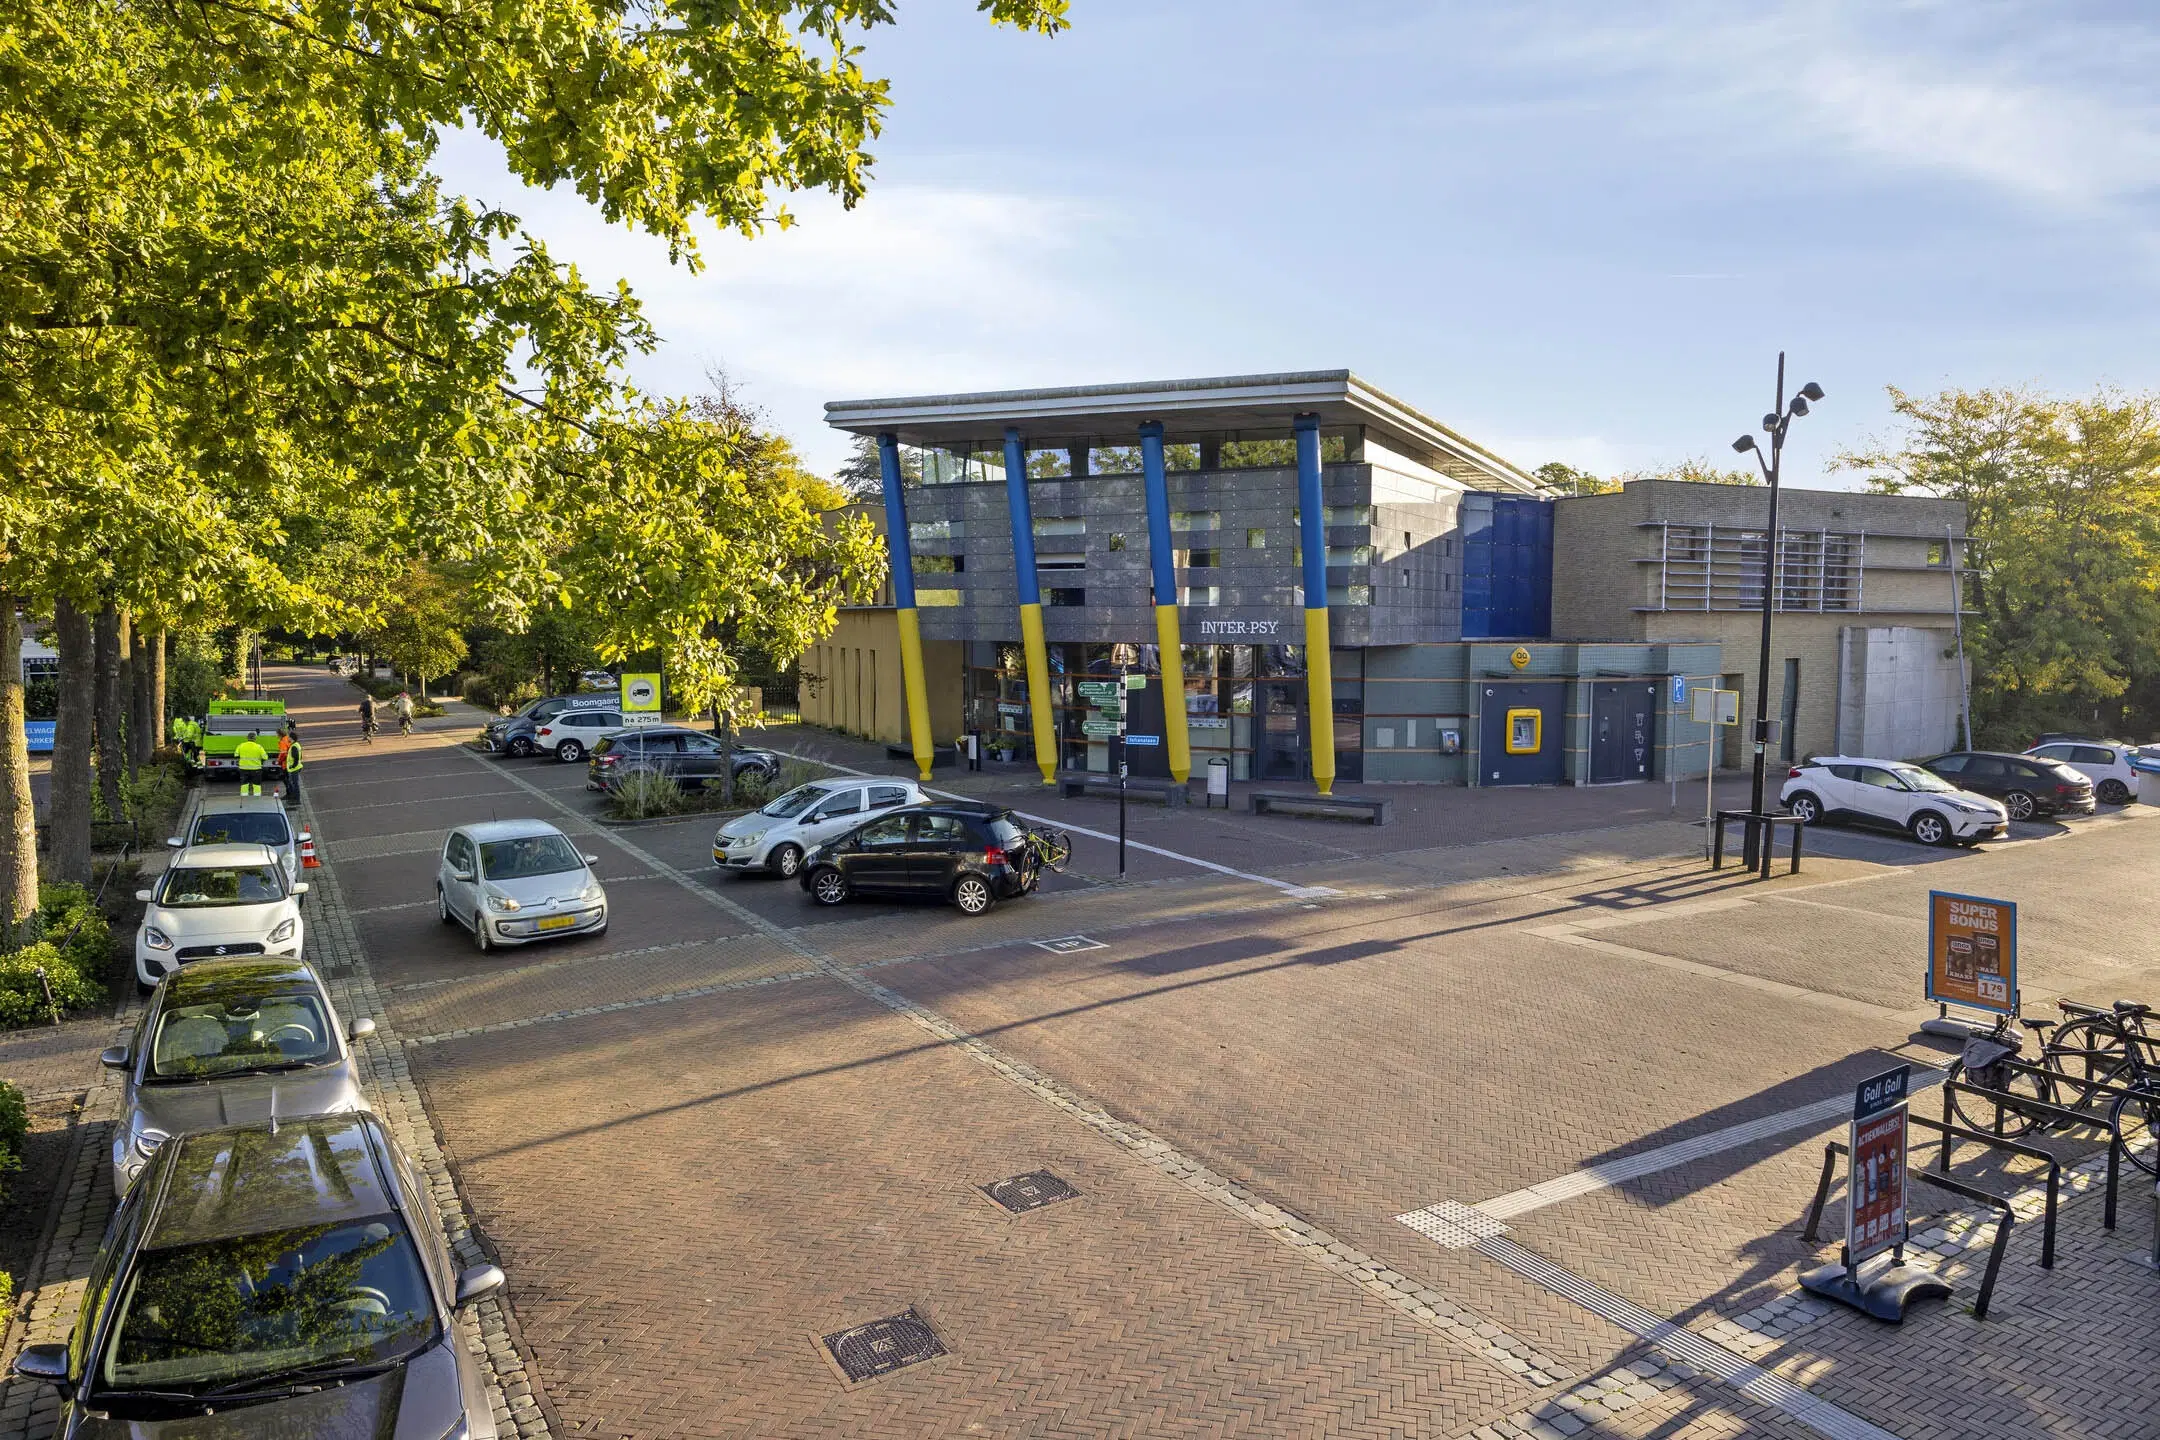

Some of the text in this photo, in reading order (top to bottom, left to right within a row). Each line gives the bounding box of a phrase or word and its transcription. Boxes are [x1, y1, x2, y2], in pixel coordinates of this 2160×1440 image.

[1201, 620, 1278, 634] INTER-PSY
[1675, 679, 1682, 691] P
[572, 697, 620, 707] Boomgaard
[1949, 901, 1998, 920] SUPER
[1949, 913, 1999, 932] BONUS
[1863, 1082, 1882, 1103] Gall
[1884, 1073, 1902, 1094] Gall
